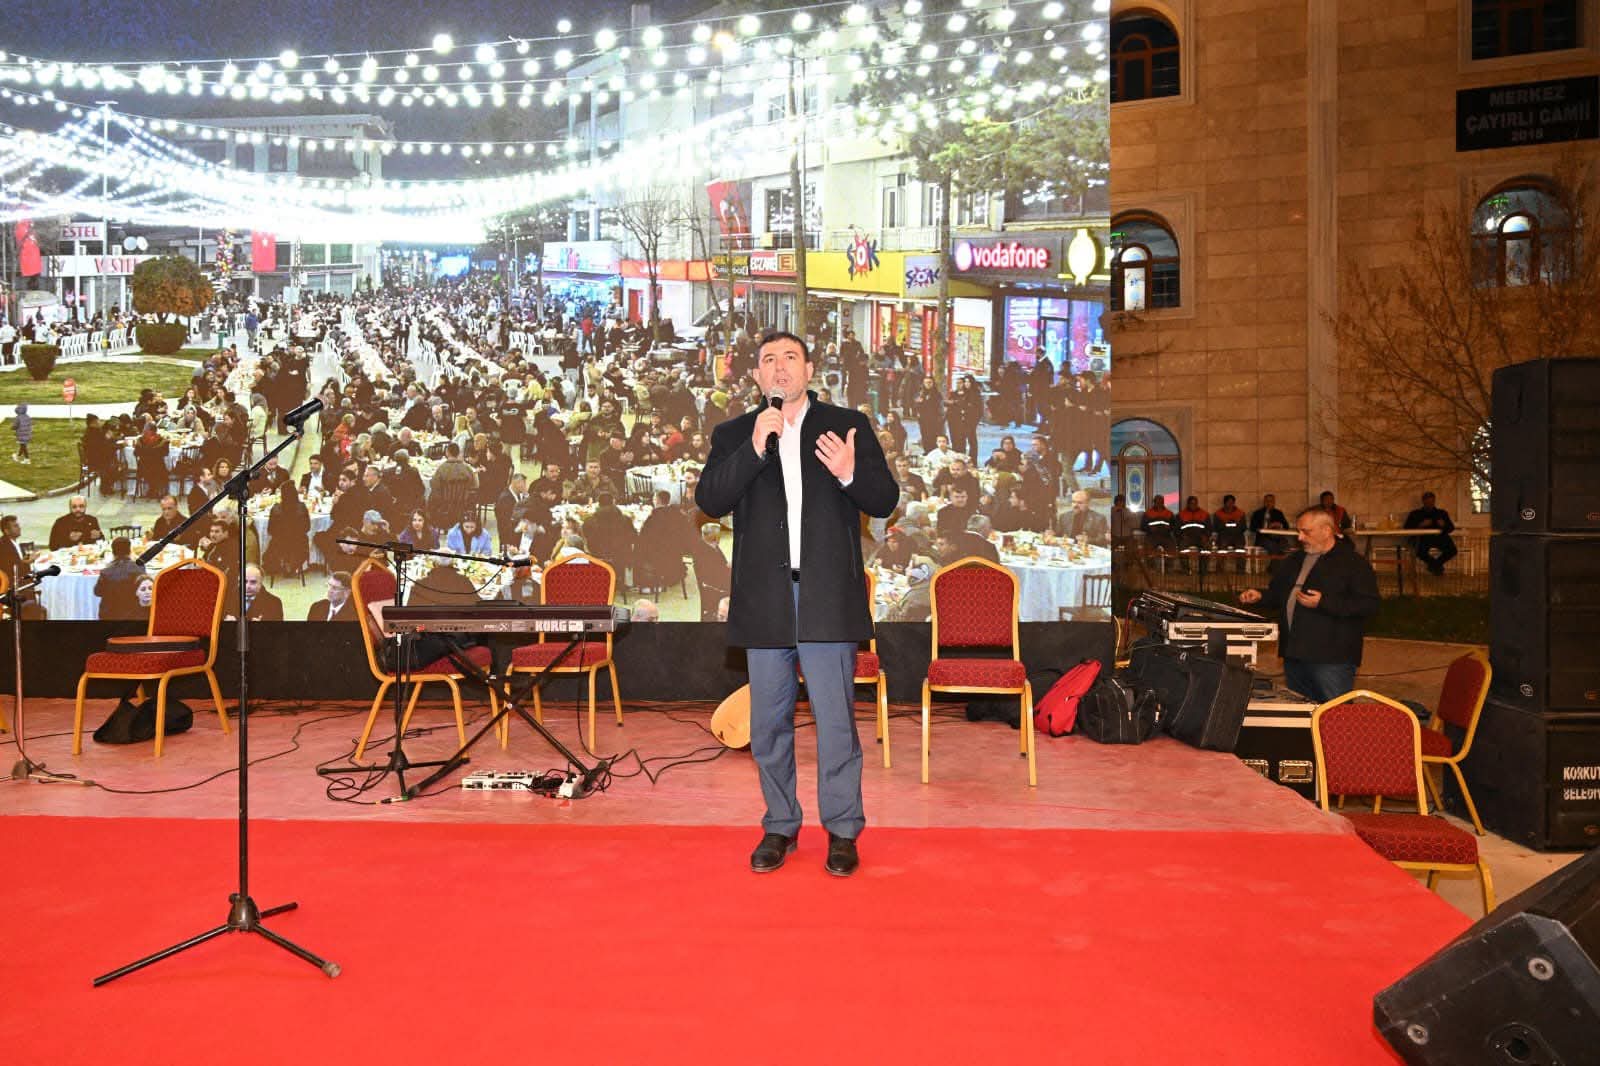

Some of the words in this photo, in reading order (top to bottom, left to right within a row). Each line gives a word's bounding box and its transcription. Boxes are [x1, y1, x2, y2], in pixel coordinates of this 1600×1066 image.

[1489, 84, 1567, 106] MERKEZ
[59, 226, 99, 238] ESTEL
[972, 242, 1048, 268] vodafone
[535, 619, 567, 632] KORG
